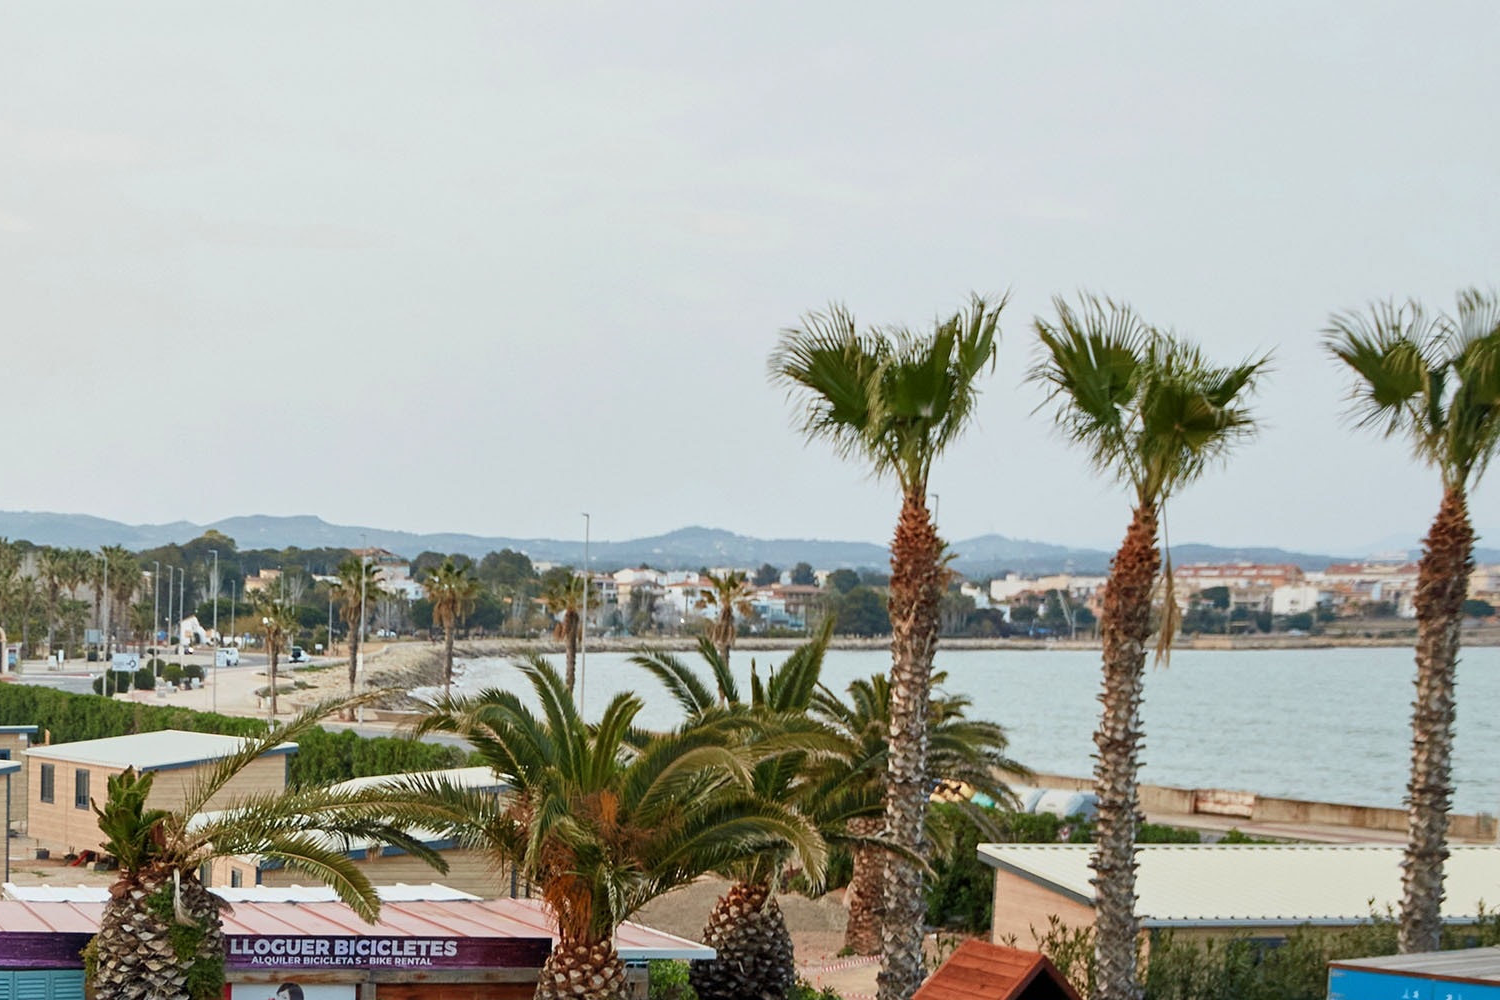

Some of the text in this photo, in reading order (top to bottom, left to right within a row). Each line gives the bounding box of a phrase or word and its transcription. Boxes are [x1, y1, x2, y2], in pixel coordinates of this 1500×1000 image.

[230, 939, 457, 957] LLOGUER BICICLETES
[251, 956, 301, 966] ALQUILER
[303, 957, 361, 965] BICICLETAS
[369, 957, 392, 965] BIKE
[395, 957, 433, 966] RENTAL
